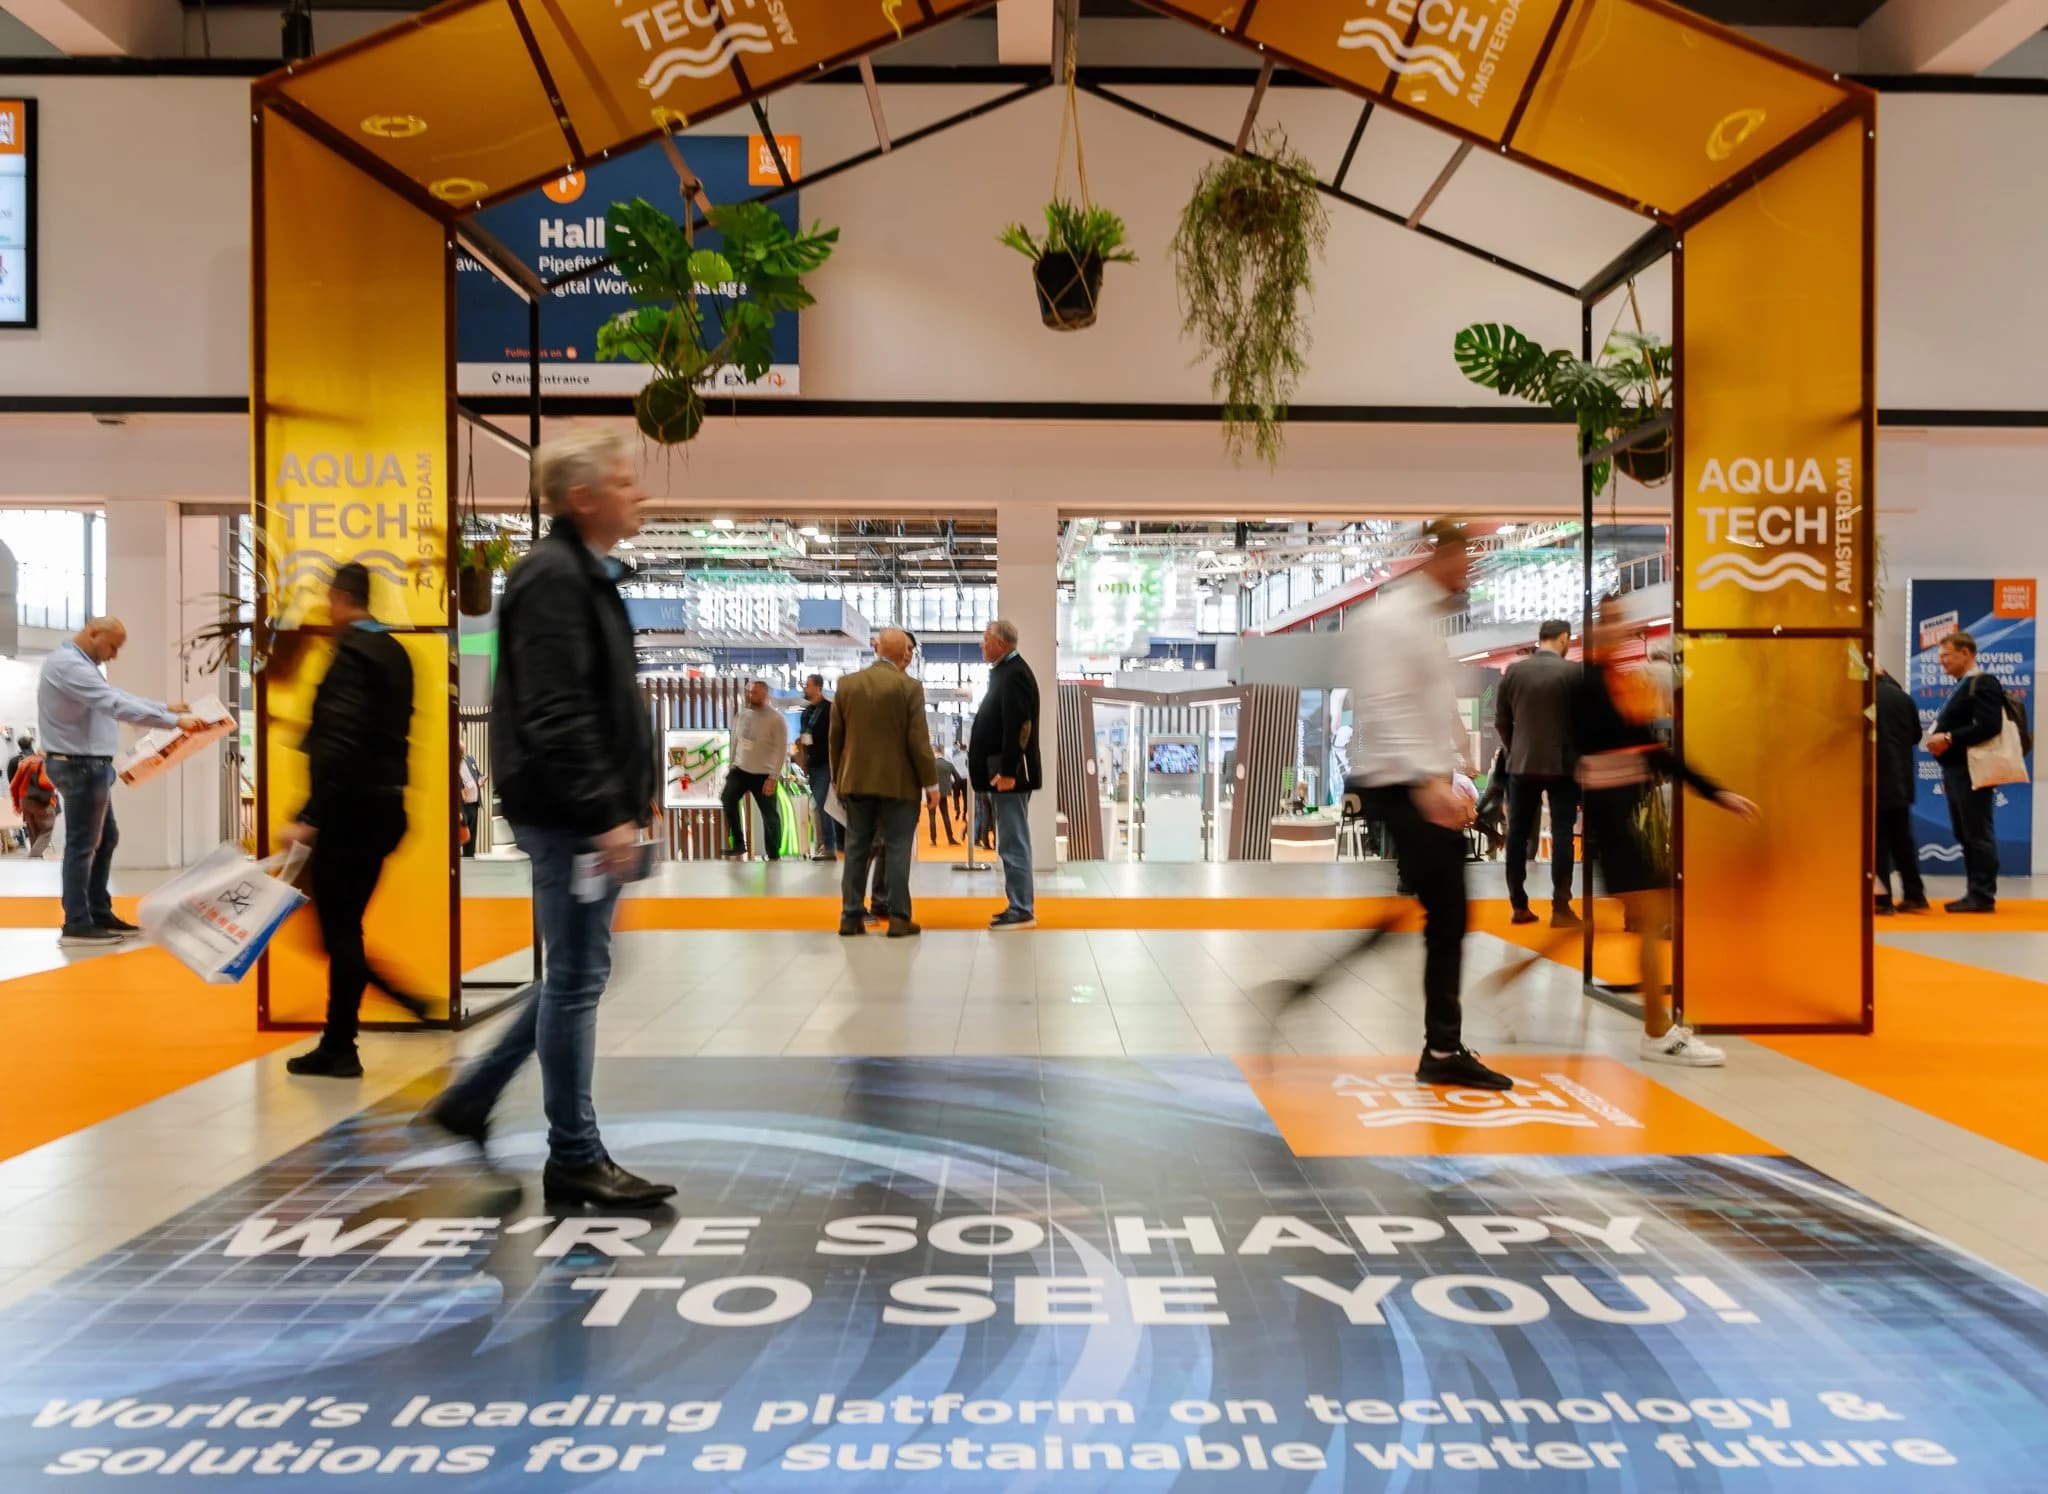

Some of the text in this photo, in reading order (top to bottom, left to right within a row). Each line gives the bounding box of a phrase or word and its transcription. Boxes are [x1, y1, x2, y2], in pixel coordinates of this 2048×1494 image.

[538, 217, 606, 249] Hall
[276, 452, 407, 489] AQUA
[1697, 457, 1828, 495] AQUA
[276, 501, 408, 540] TECH
[417, 449, 434, 590] AMSTERDAM
[1696, 505, 1828, 546] TECH
[1835, 456, 1853, 595] AMSTERDAM
[1336, 1089, 1569, 1108] TECH
[815, 1214, 1044, 1256] SO
[1114, 1215, 1645, 1256] HAPPY
[571, 1273, 1761, 1327] TO SEE YOU!
[31, 1391, 1906, 1433] World's leading platform on technology &
[43, 1433, 1958, 1475] solutions for a sustainable water future
